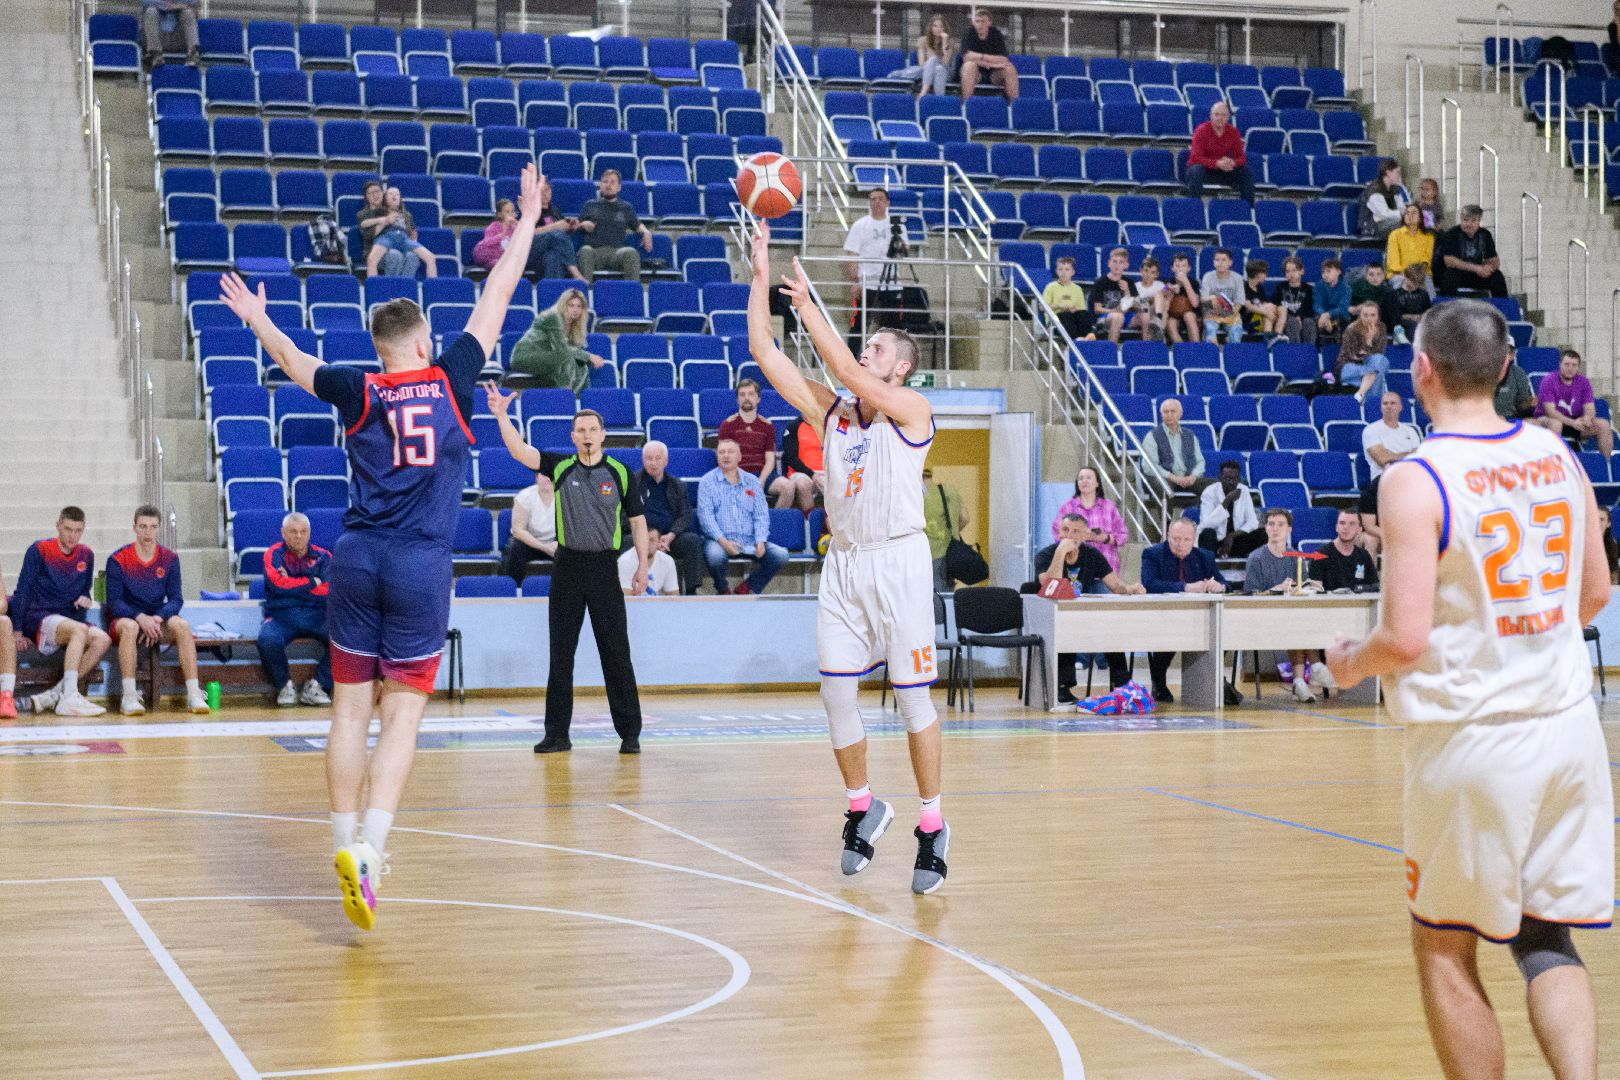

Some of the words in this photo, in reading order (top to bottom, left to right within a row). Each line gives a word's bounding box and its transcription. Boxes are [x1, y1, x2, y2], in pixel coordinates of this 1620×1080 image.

[387, 404, 436, 469] 15
[1476, 497, 1573, 604] 23
[910, 645, 933, 674] 15
